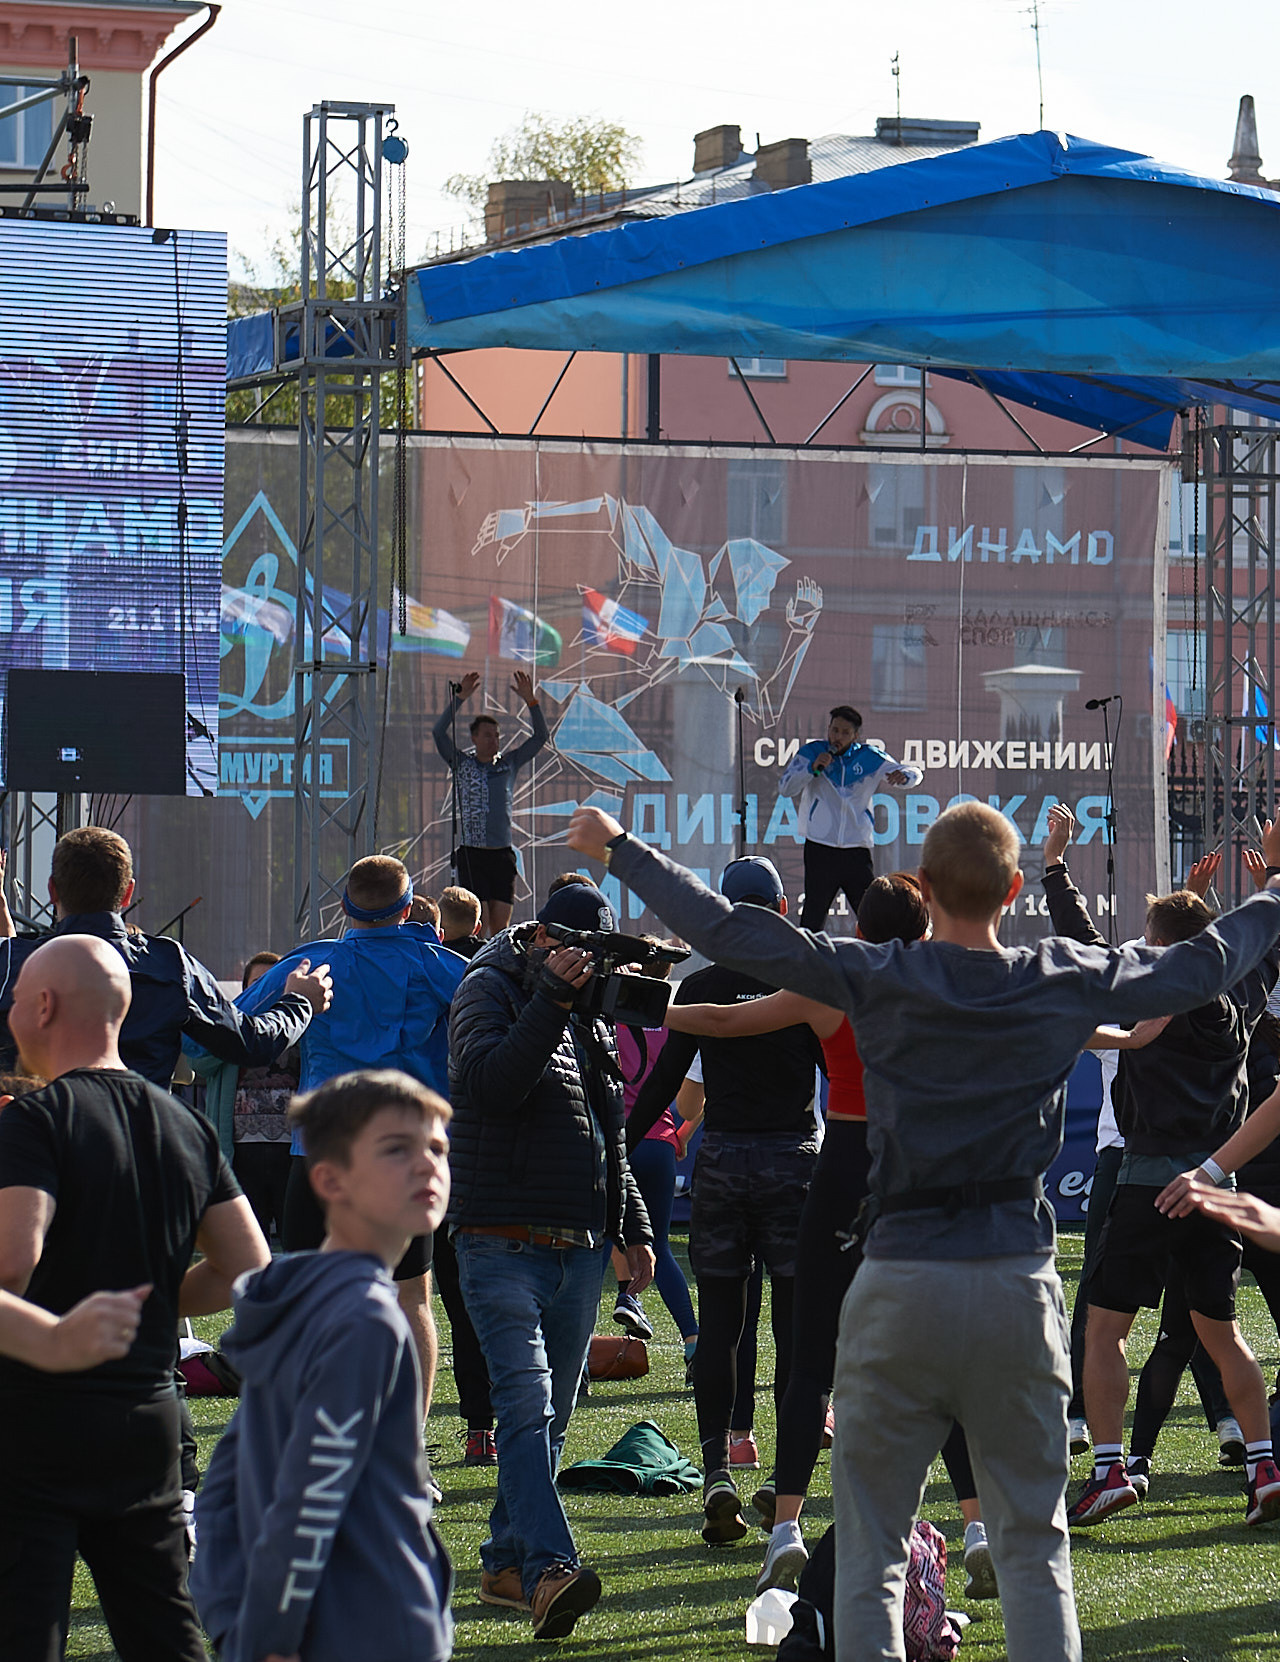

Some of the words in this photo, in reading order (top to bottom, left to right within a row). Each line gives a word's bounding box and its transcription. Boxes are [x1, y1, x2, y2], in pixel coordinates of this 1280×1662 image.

[906, 524, 1114, 565] ДИНАМО
[108, 606, 164, 630] 21.1
[900, 739, 1113, 771] ДВИЖЕНИИ!
[278, 1406, 366, 1614] THINK
